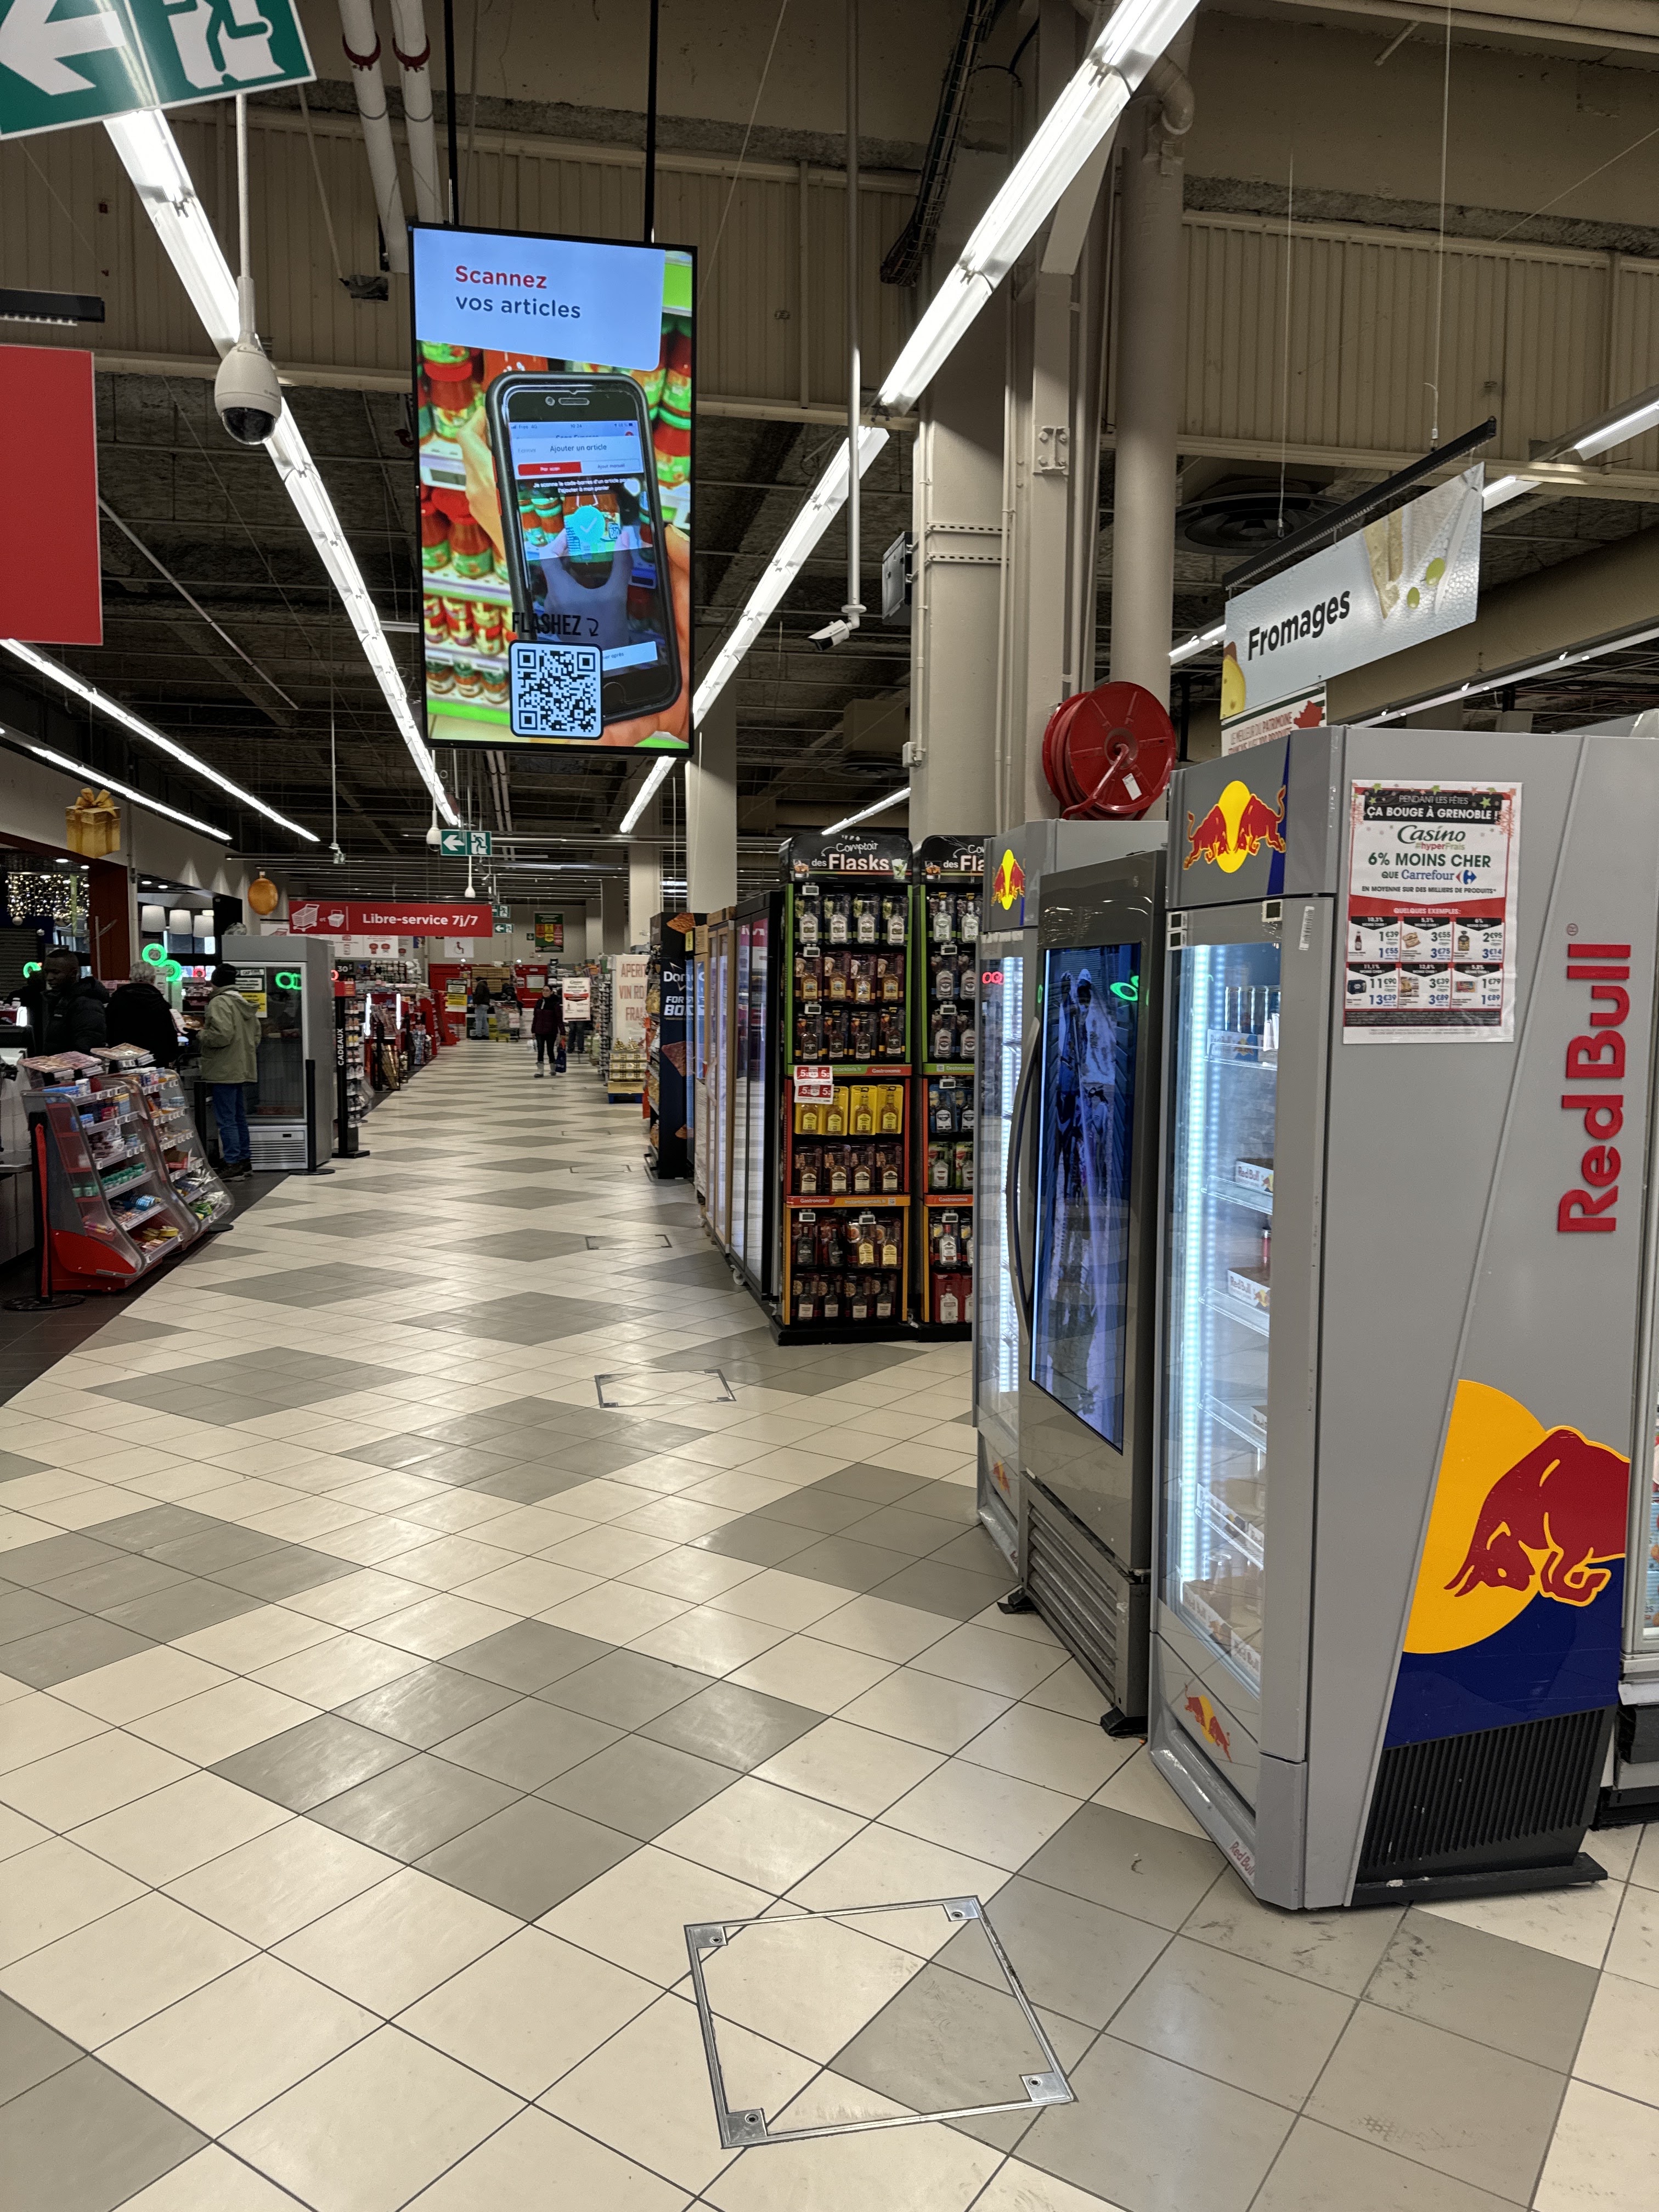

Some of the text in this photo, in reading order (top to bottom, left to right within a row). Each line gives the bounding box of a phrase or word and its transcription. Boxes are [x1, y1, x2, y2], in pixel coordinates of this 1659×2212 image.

[455, 266, 548, 289] Scannez
[455, 296, 582, 319] vos articles
[550, 444, 574, 453] Ajouter
[511, 612, 582, 636] FLASHEZ
[1248, 590, 1351, 661] Fromages
[1366, 806, 1383, 819] ÇA
[1386, 807, 1424, 817] BOUGE
[1425, 805, 1434, 818] À
[1437, 808, 1492, 820] GRENOBLE
[1397, 825, 1466, 844] Casino
[836, 840, 878, 854] Comptoir
[1415, 842, 1466, 851] #hyperFrais
[811, 853, 890, 871] des Flasks
[943, 854, 984, 871] des Fla
[1368, 852, 1492, 868] 6% MOINS CHER
[1381, 869, 1455, 881] QUE Carrefour
[362, 913, 448, 926] Libre-service
[452, 915, 479, 927] 7j/7
[620, 963, 647, 978] APERIT
[618, 985, 632, 1000] VIN
[336, 1028, 345, 1066] CADEAUX
[1557, 943, 1632, 1232] Red Bull
[1229, 1841, 1255, 1876] Red Bull
